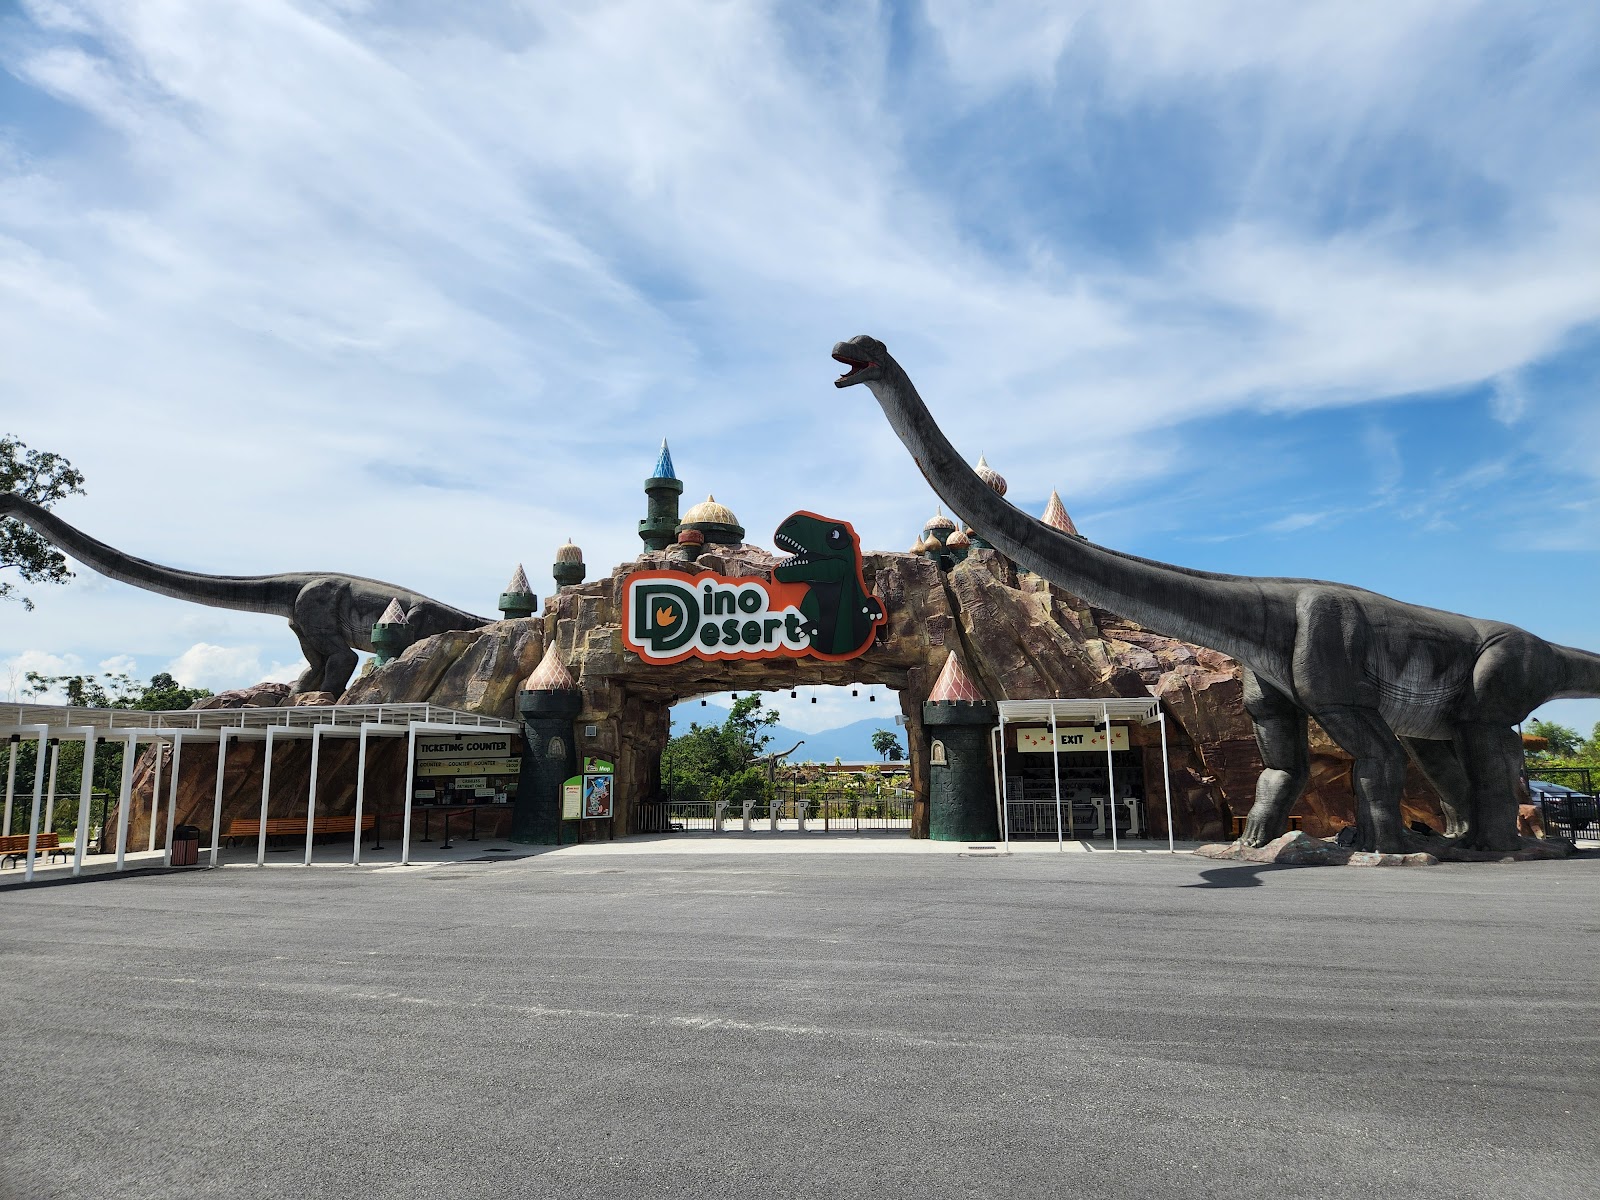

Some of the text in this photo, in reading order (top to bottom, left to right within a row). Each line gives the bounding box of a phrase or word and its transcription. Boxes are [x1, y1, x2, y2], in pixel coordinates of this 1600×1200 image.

[635, 584, 762, 638] Dino
[651, 596, 802, 651] Desert
[421, 742, 507, 752] TICKETING COUNTER
[1061, 735, 1083, 744] EXIT
